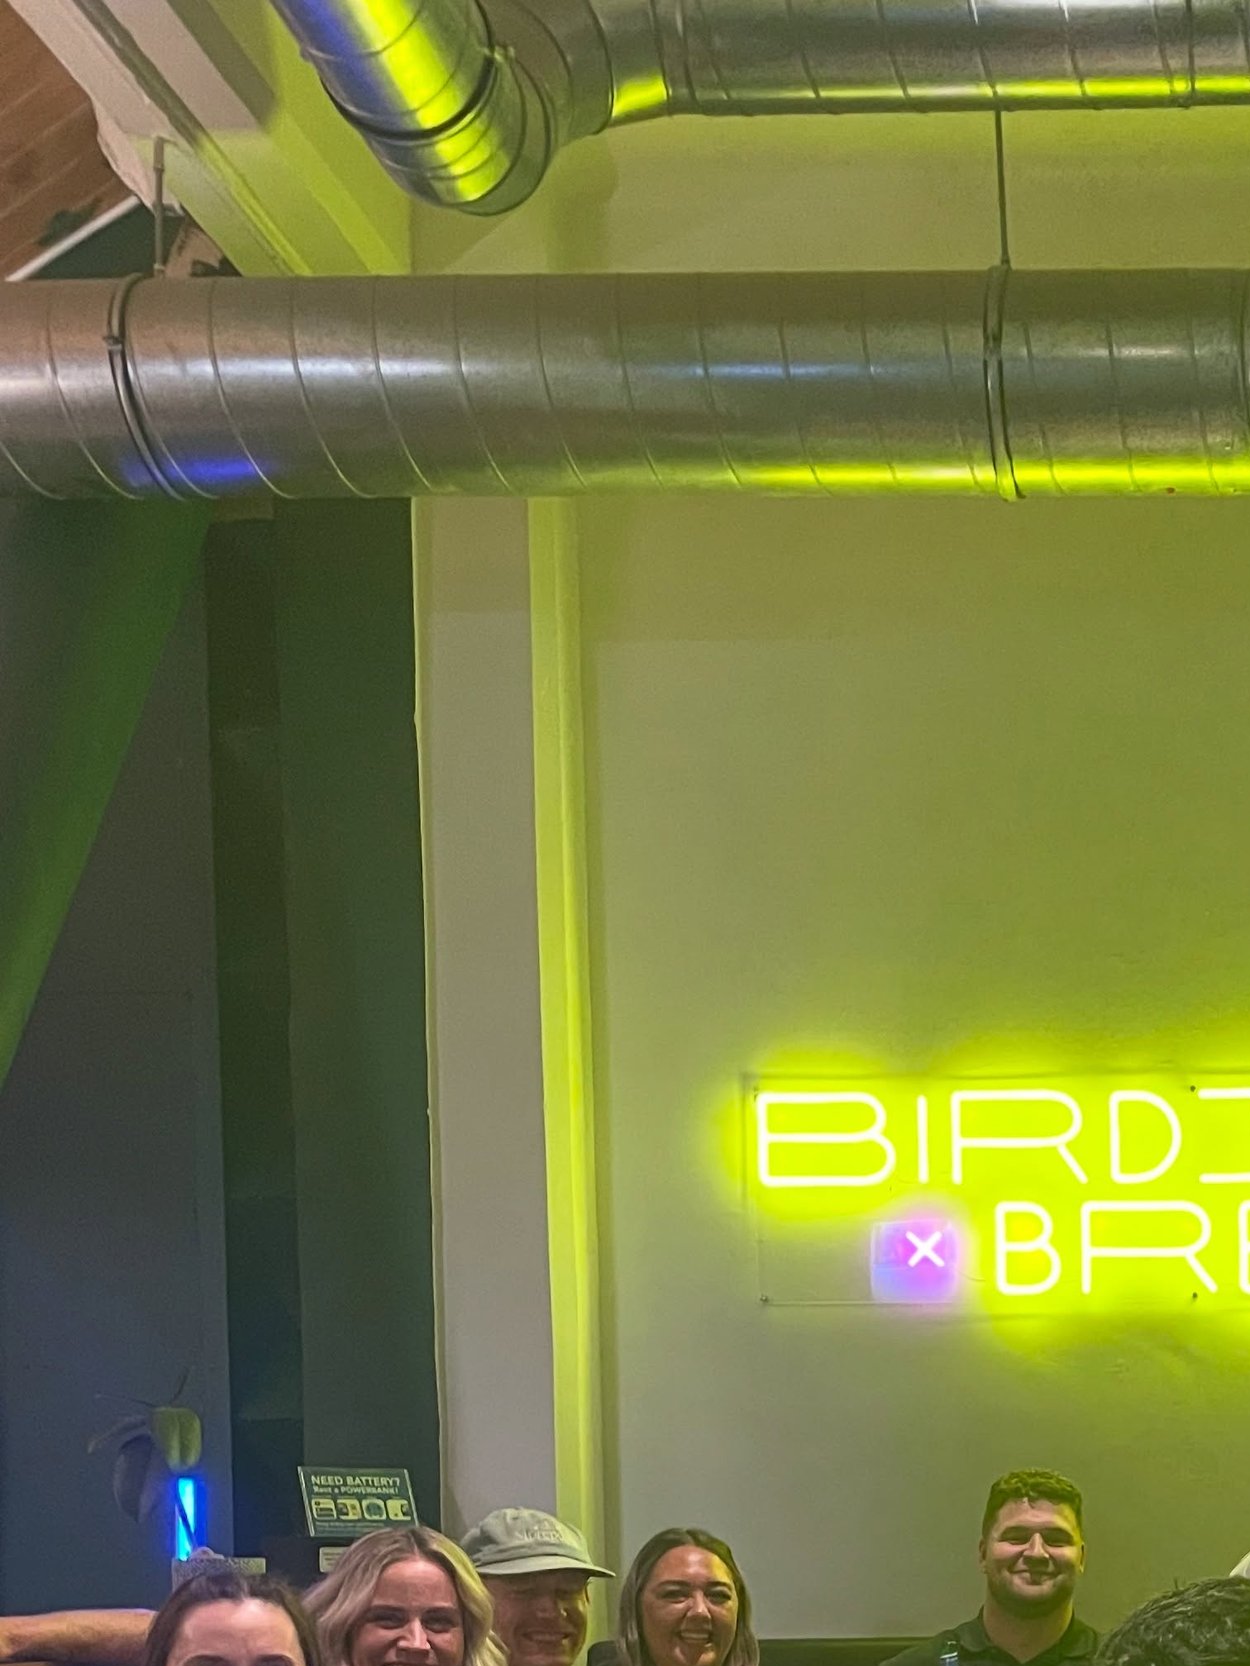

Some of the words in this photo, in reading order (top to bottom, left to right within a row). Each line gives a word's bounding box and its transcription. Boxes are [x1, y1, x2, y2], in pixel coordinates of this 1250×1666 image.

[311, 1475, 343, 1486] NEED
[346, 1476, 400, 1487] BATTERY?
[341, 1486, 399, 1495] POWERBANK!
